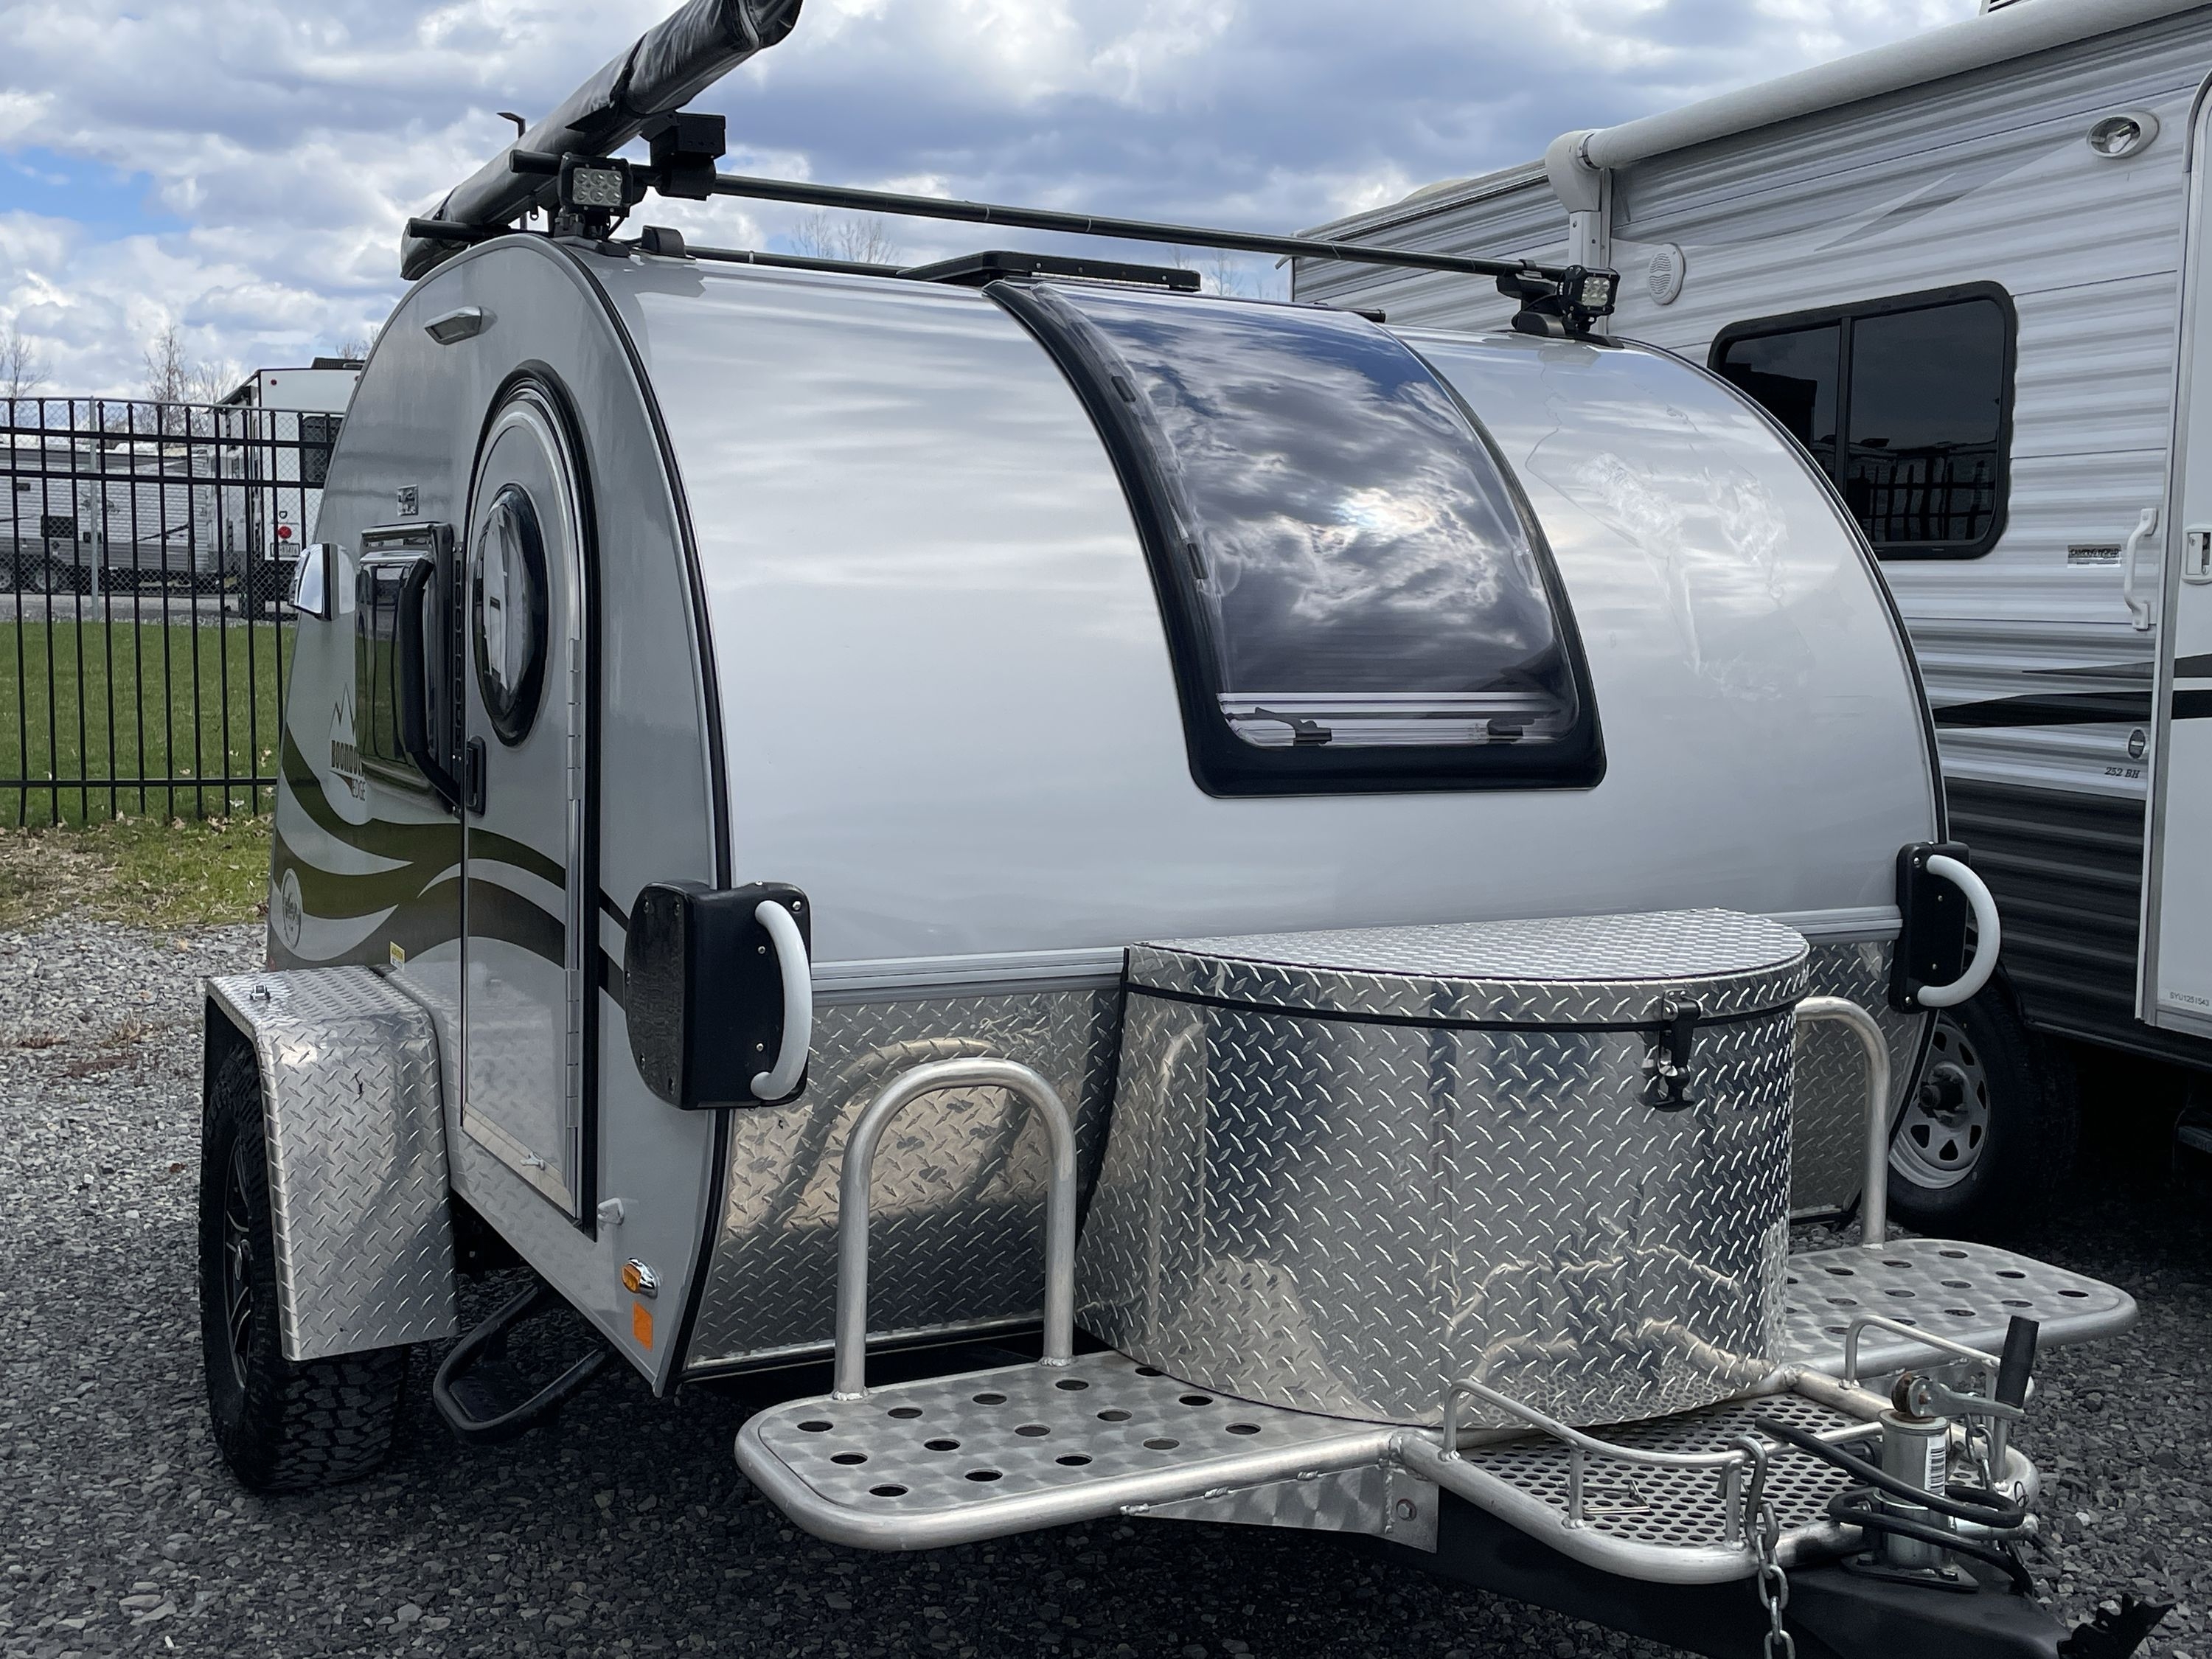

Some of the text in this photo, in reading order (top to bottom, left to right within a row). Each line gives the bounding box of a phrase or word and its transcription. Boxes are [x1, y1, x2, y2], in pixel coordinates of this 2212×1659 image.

[2104, 767, 2140, 779] 252 BH
[352, 779, 366, 801] EDGE
